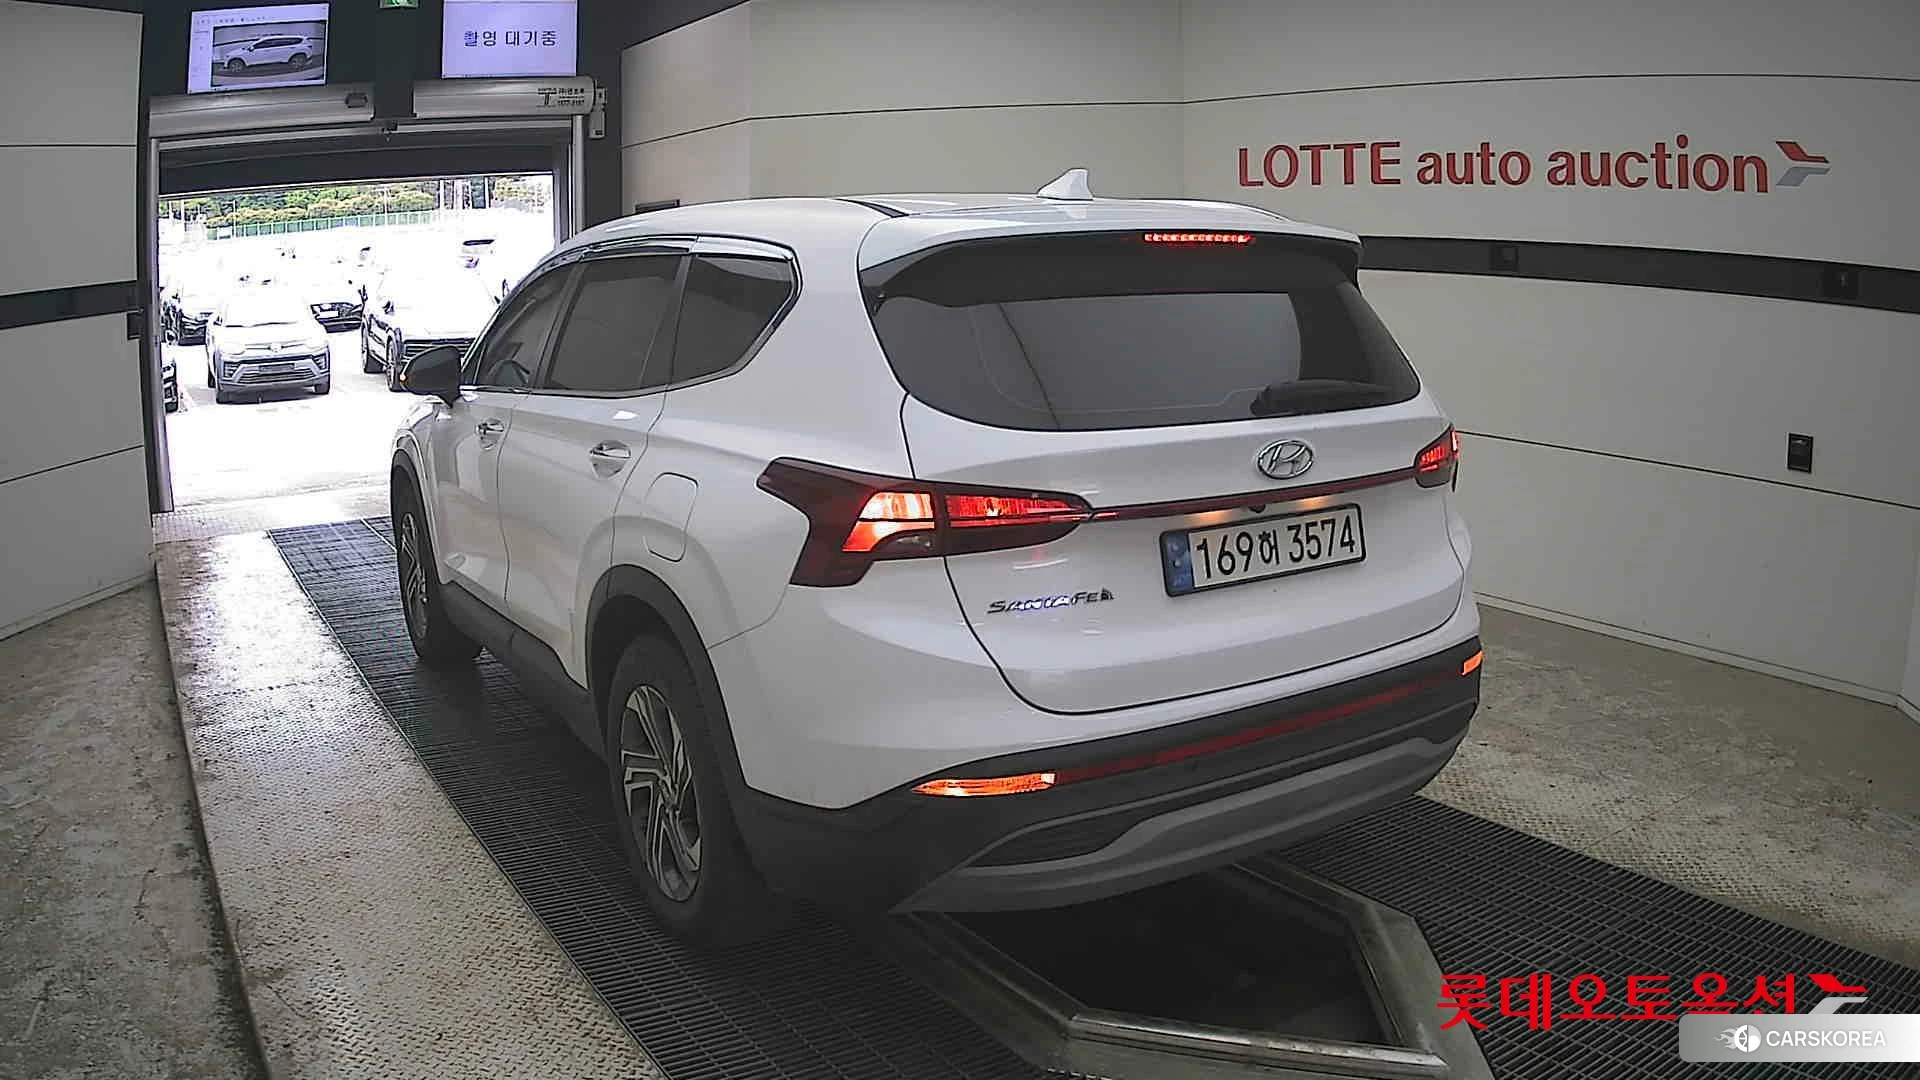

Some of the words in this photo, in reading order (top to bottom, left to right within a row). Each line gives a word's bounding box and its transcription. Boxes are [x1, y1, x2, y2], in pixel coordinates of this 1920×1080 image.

[505, 30, 557, 47] 대기중
[1239, 141, 1401, 187] LOTTE
[1416, 142, 1531, 186] auto
[1547, 134, 1769, 193] auction
[1197, 529, 1280, 579] 169허
[1287, 515, 1356, 563] 3574
